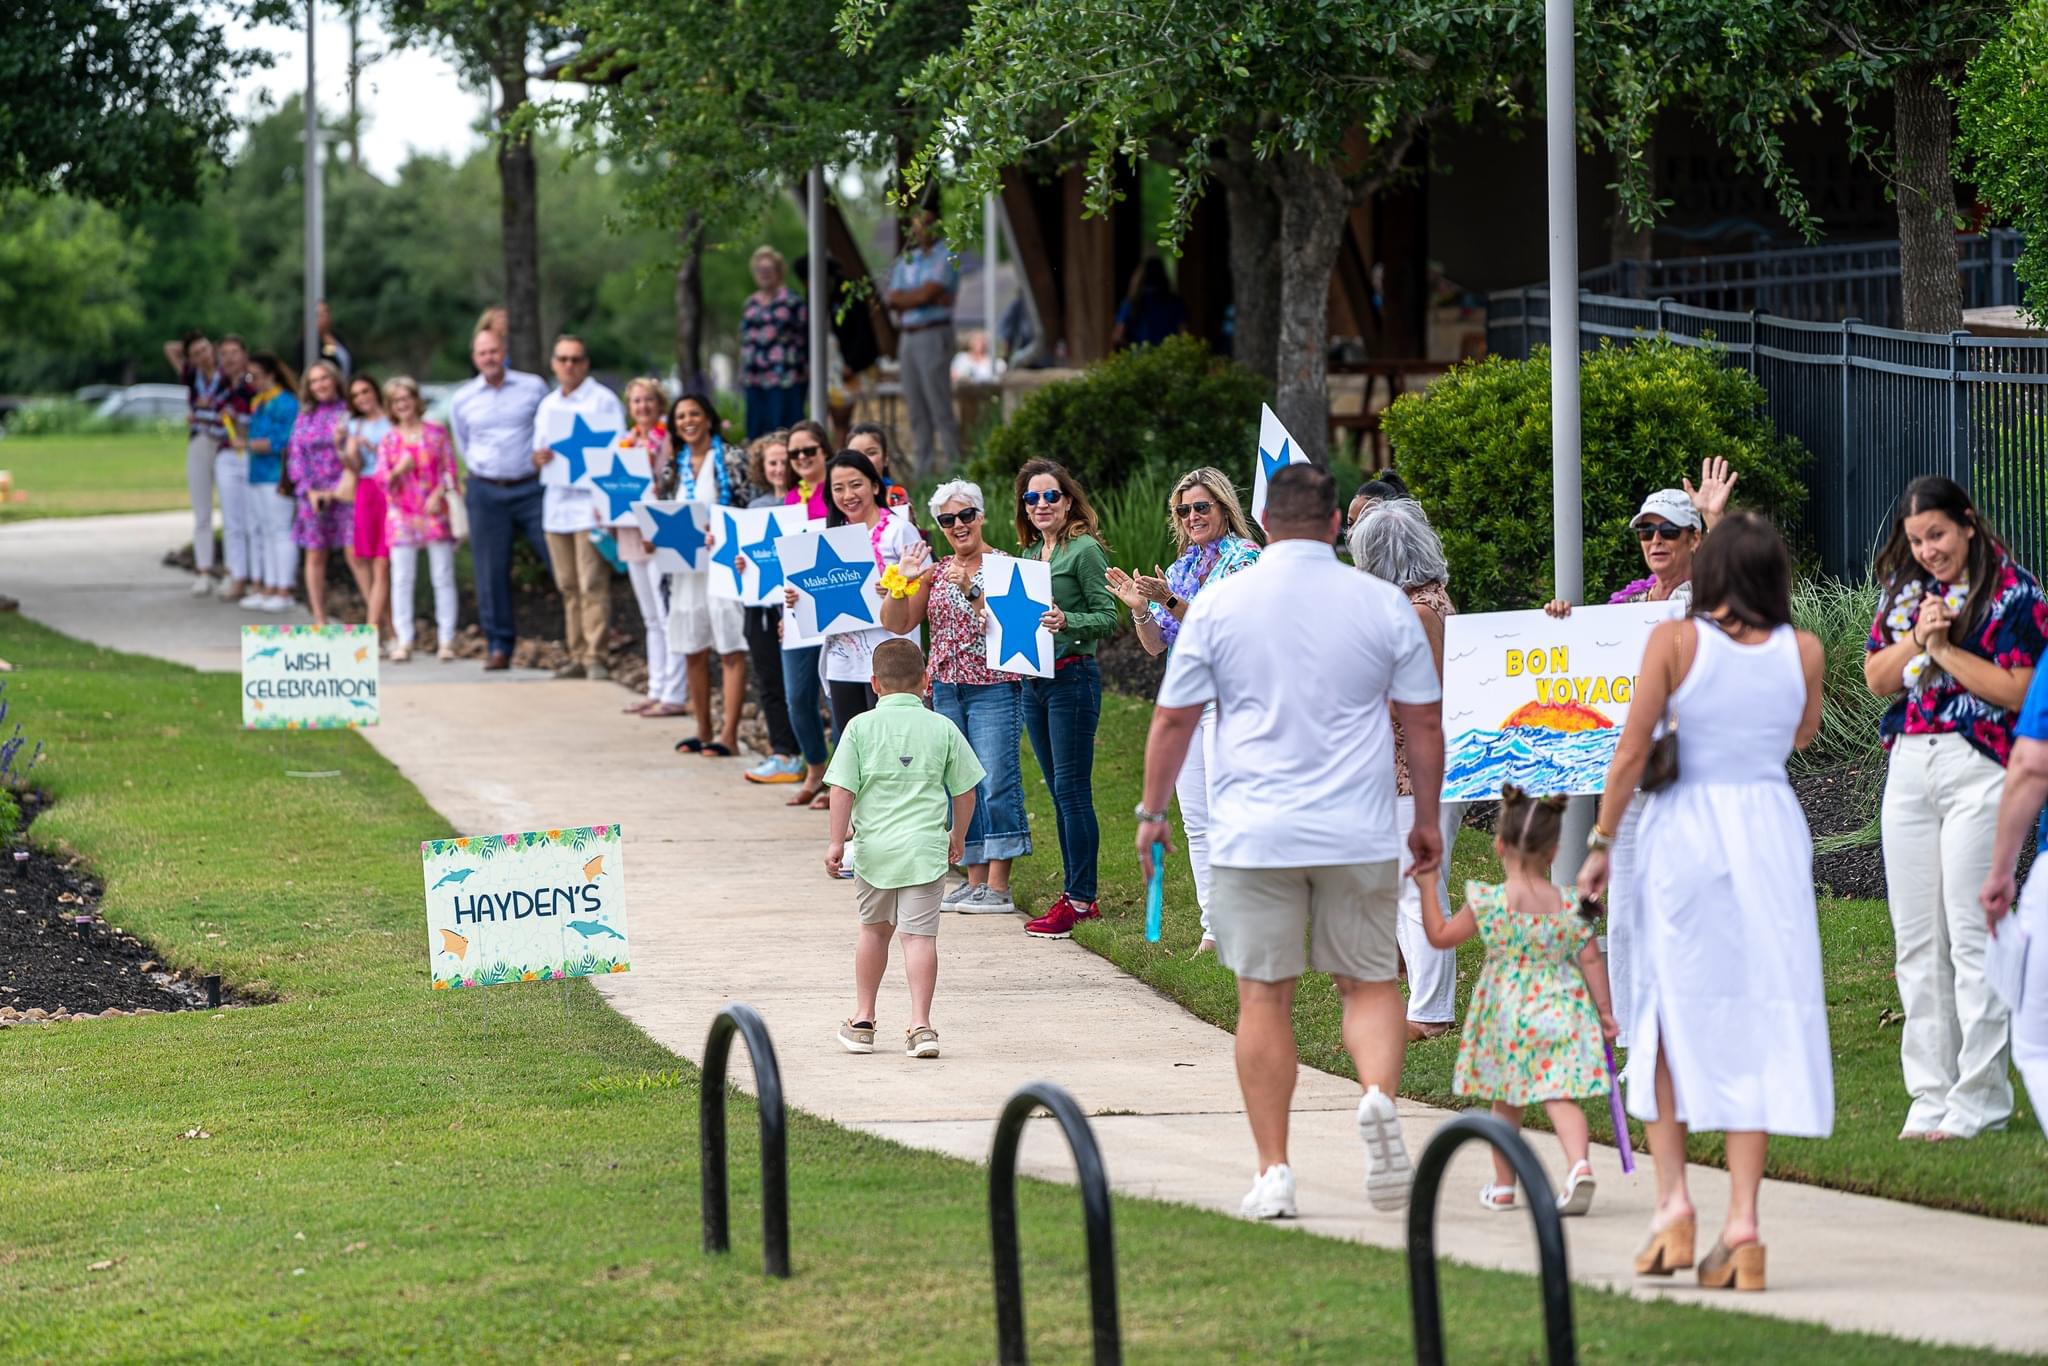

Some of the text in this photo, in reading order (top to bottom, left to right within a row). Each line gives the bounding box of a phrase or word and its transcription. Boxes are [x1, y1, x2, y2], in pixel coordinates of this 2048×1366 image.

[803, 575, 829, 588] Make
[837, 569, 862, 582] Wish
[284, 652, 331, 671] WISH
[1506, 645, 1569, 677] BON
[245, 679, 377, 699] CELEBRATION!
[454, 883, 602, 925] HAYDEN'S
